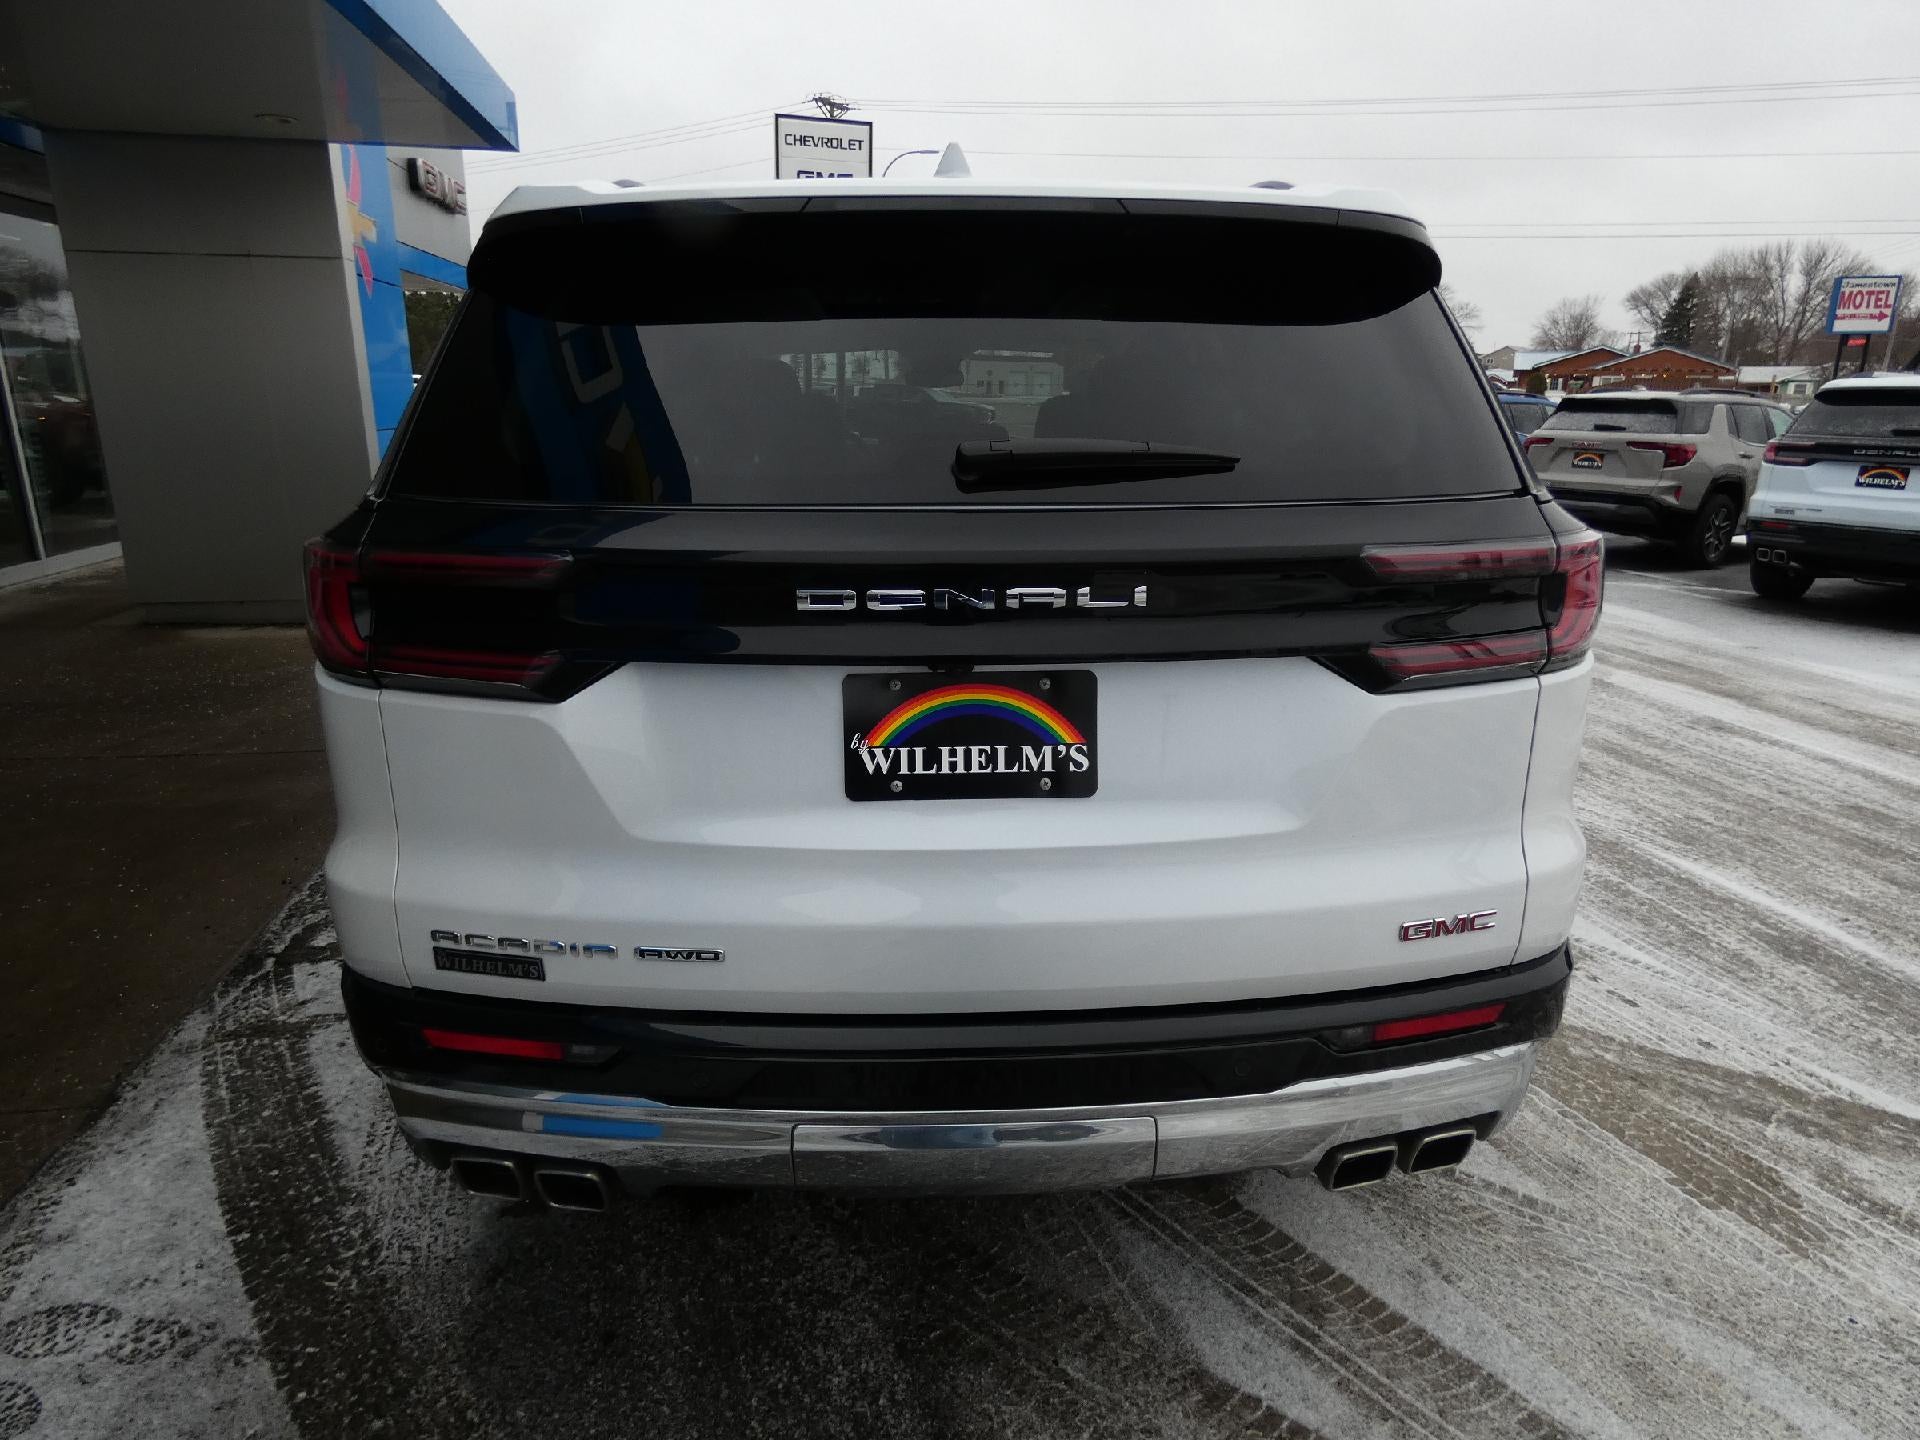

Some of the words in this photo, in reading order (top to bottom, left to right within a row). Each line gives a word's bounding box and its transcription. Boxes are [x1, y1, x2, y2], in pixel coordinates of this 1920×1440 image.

[784, 133, 865, 151] CHEVROLET
[1838, 290, 1892, 310] MOTEL
[796, 585, 1148, 611] DENALI
[850, 732, 869, 755] by
[858, 743, 1091, 775] WILHELM'S
[1399, 909, 1498, 942] GMC
[430, 929, 618, 960] ACADIA
[634, 945, 726, 962] AWD
[436, 951, 541, 978] WILHELM'S
